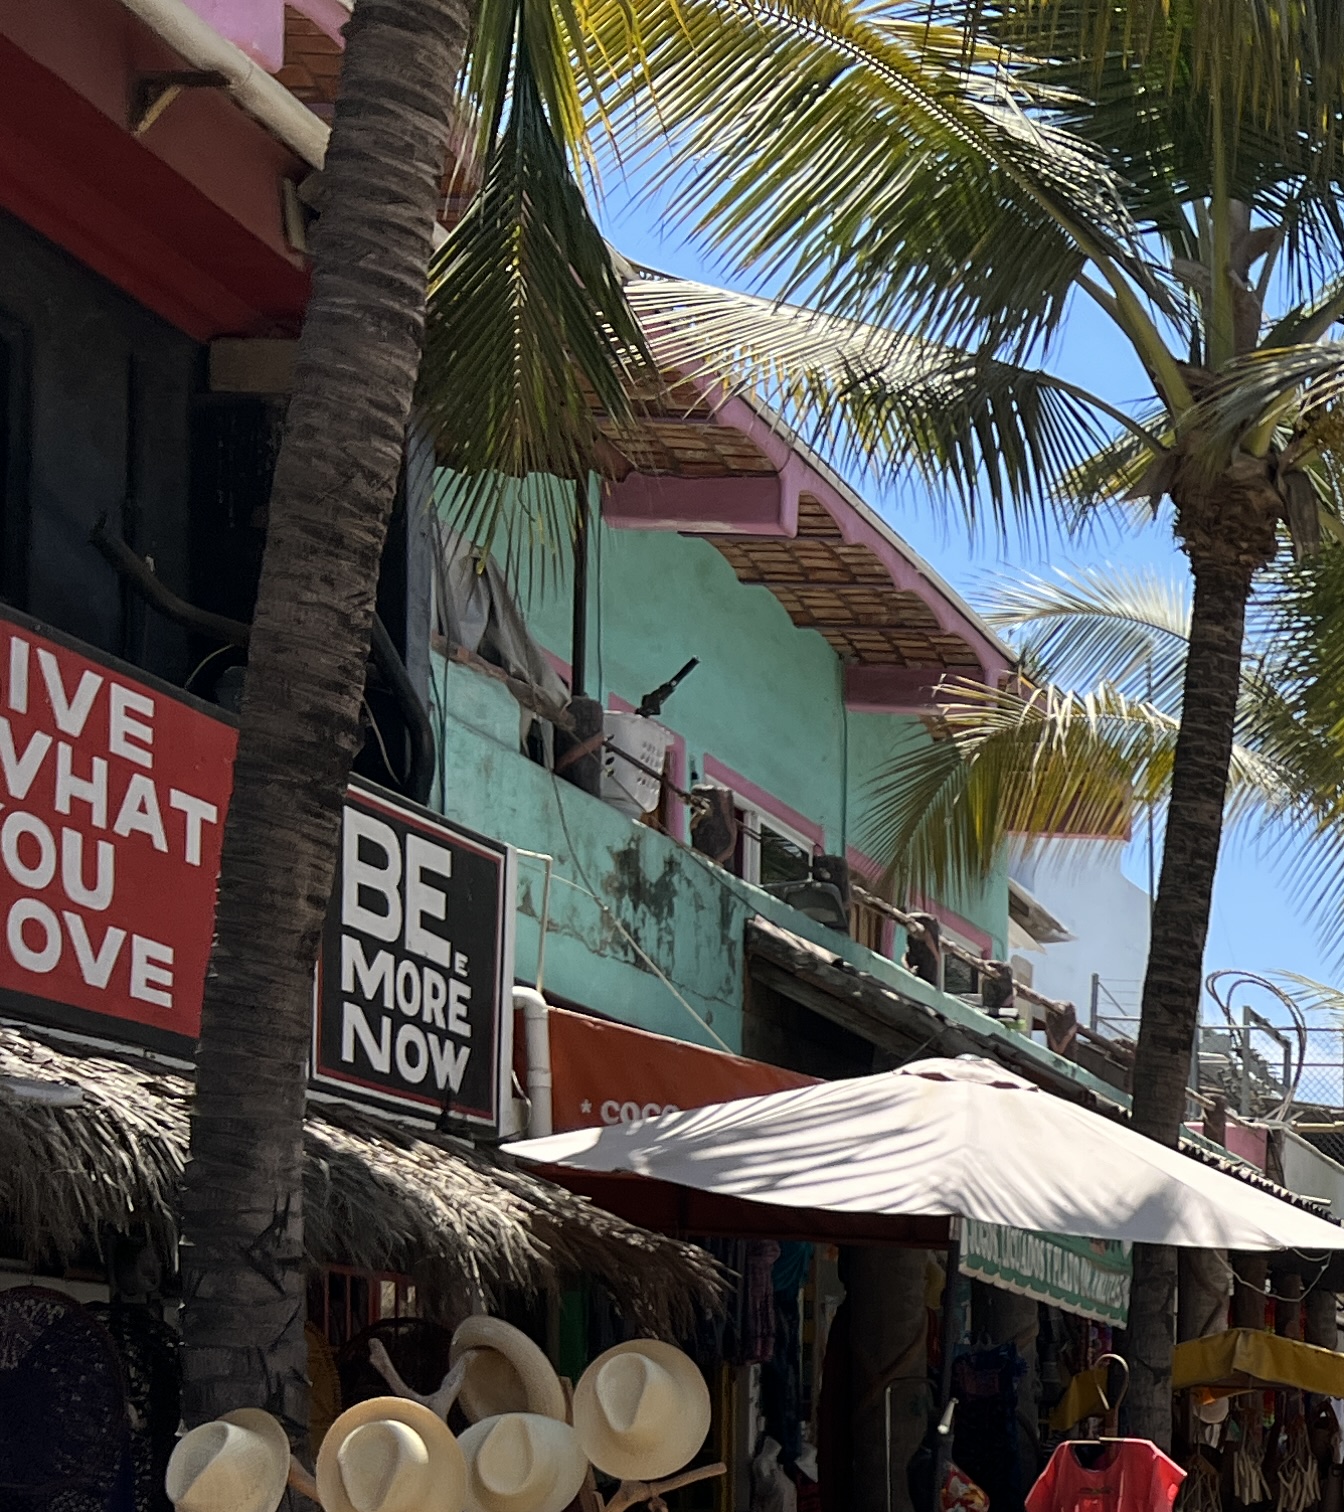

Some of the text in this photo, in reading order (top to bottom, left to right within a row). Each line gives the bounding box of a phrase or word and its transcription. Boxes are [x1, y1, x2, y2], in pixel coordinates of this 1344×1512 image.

[9, 635, 155, 769] IVE
[0, 810, 116, 911] OU
[341, 804, 452, 969] BE
[6, 897, 175, 1009] OVE
[341, 933, 472, 1019] MORE
[341, 1000, 472, 1095] NOW
